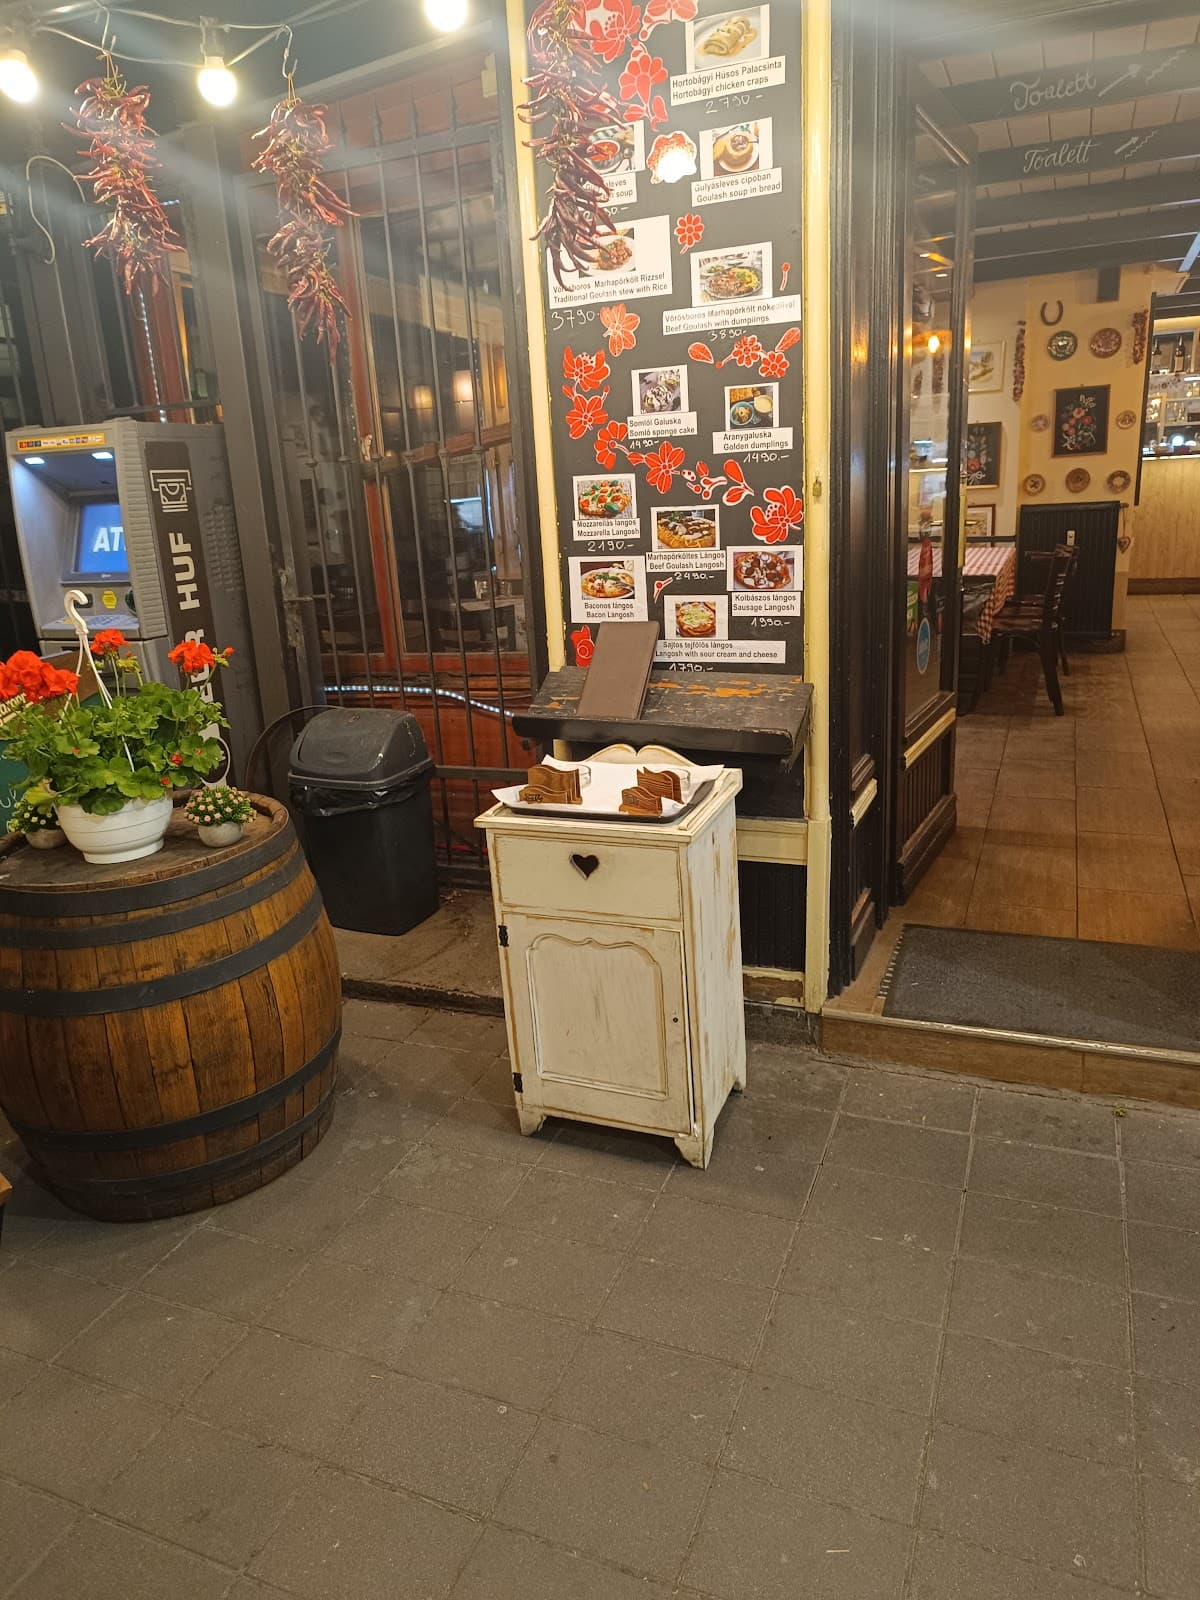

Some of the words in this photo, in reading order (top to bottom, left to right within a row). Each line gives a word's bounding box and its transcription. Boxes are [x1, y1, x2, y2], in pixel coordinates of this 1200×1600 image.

[741, 61, 782, 75] Palacsinta
[715, 79, 745, 92] chicken
[746, 75, 769, 87] craps
[1009, 69, 1097, 111] Toalett
[1023, 139, 1101, 173] Toalett
[615, 189, 634, 198] soup
[696, 190, 728, 203] Goulash
[729, 188, 748, 198] soup
[749, 185, 757, 193] in
[759, 182, 781, 193] bread
[554, 293, 588, 304] Traditional
[589, 289, 617, 299] Goulash
[618, 287, 634, 295] stew
[636, 285, 651, 293] with
[652, 283, 668, 291] Rice
[665, 325, 681, 333] Beef
[683, 321, 713, 331] Goulash
[714, 319, 730, 327] with
[731, 315, 770, 326] dumplings
[654, 417, 682, 426] Galuska
[652, 427, 678, 438] sponge
[678, 426, 695, 434] cake
[723, 430, 772, 441] Aranygaluska
[723, 442, 749, 451] Golden
[750, 439, 789, 449] dumplings
[577, 529, 610, 537] Mozzarella
[611, 528, 640, 537] Langosh
[93, 526, 127, 553] AT
[649, 562, 665, 570] Beef
[666, 561, 694, 570] Goulash
[695, 560, 725, 570] Langosh
[168, 532, 201, 611] HUF
[584, 602, 611, 610] Baconos
[732, 603, 763, 613] Sausage
[764, 603, 795, 613] Langosh
[586, 611, 606, 619] Bacon
[607, 611, 635, 620] Langosh
[663, 641, 683, 650] Sajtos
[655, 650, 681, 659] Langosh
[684, 650, 699, 658] with
[738, 650, 752, 658] and
[753, 650, 778, 659] cheese
